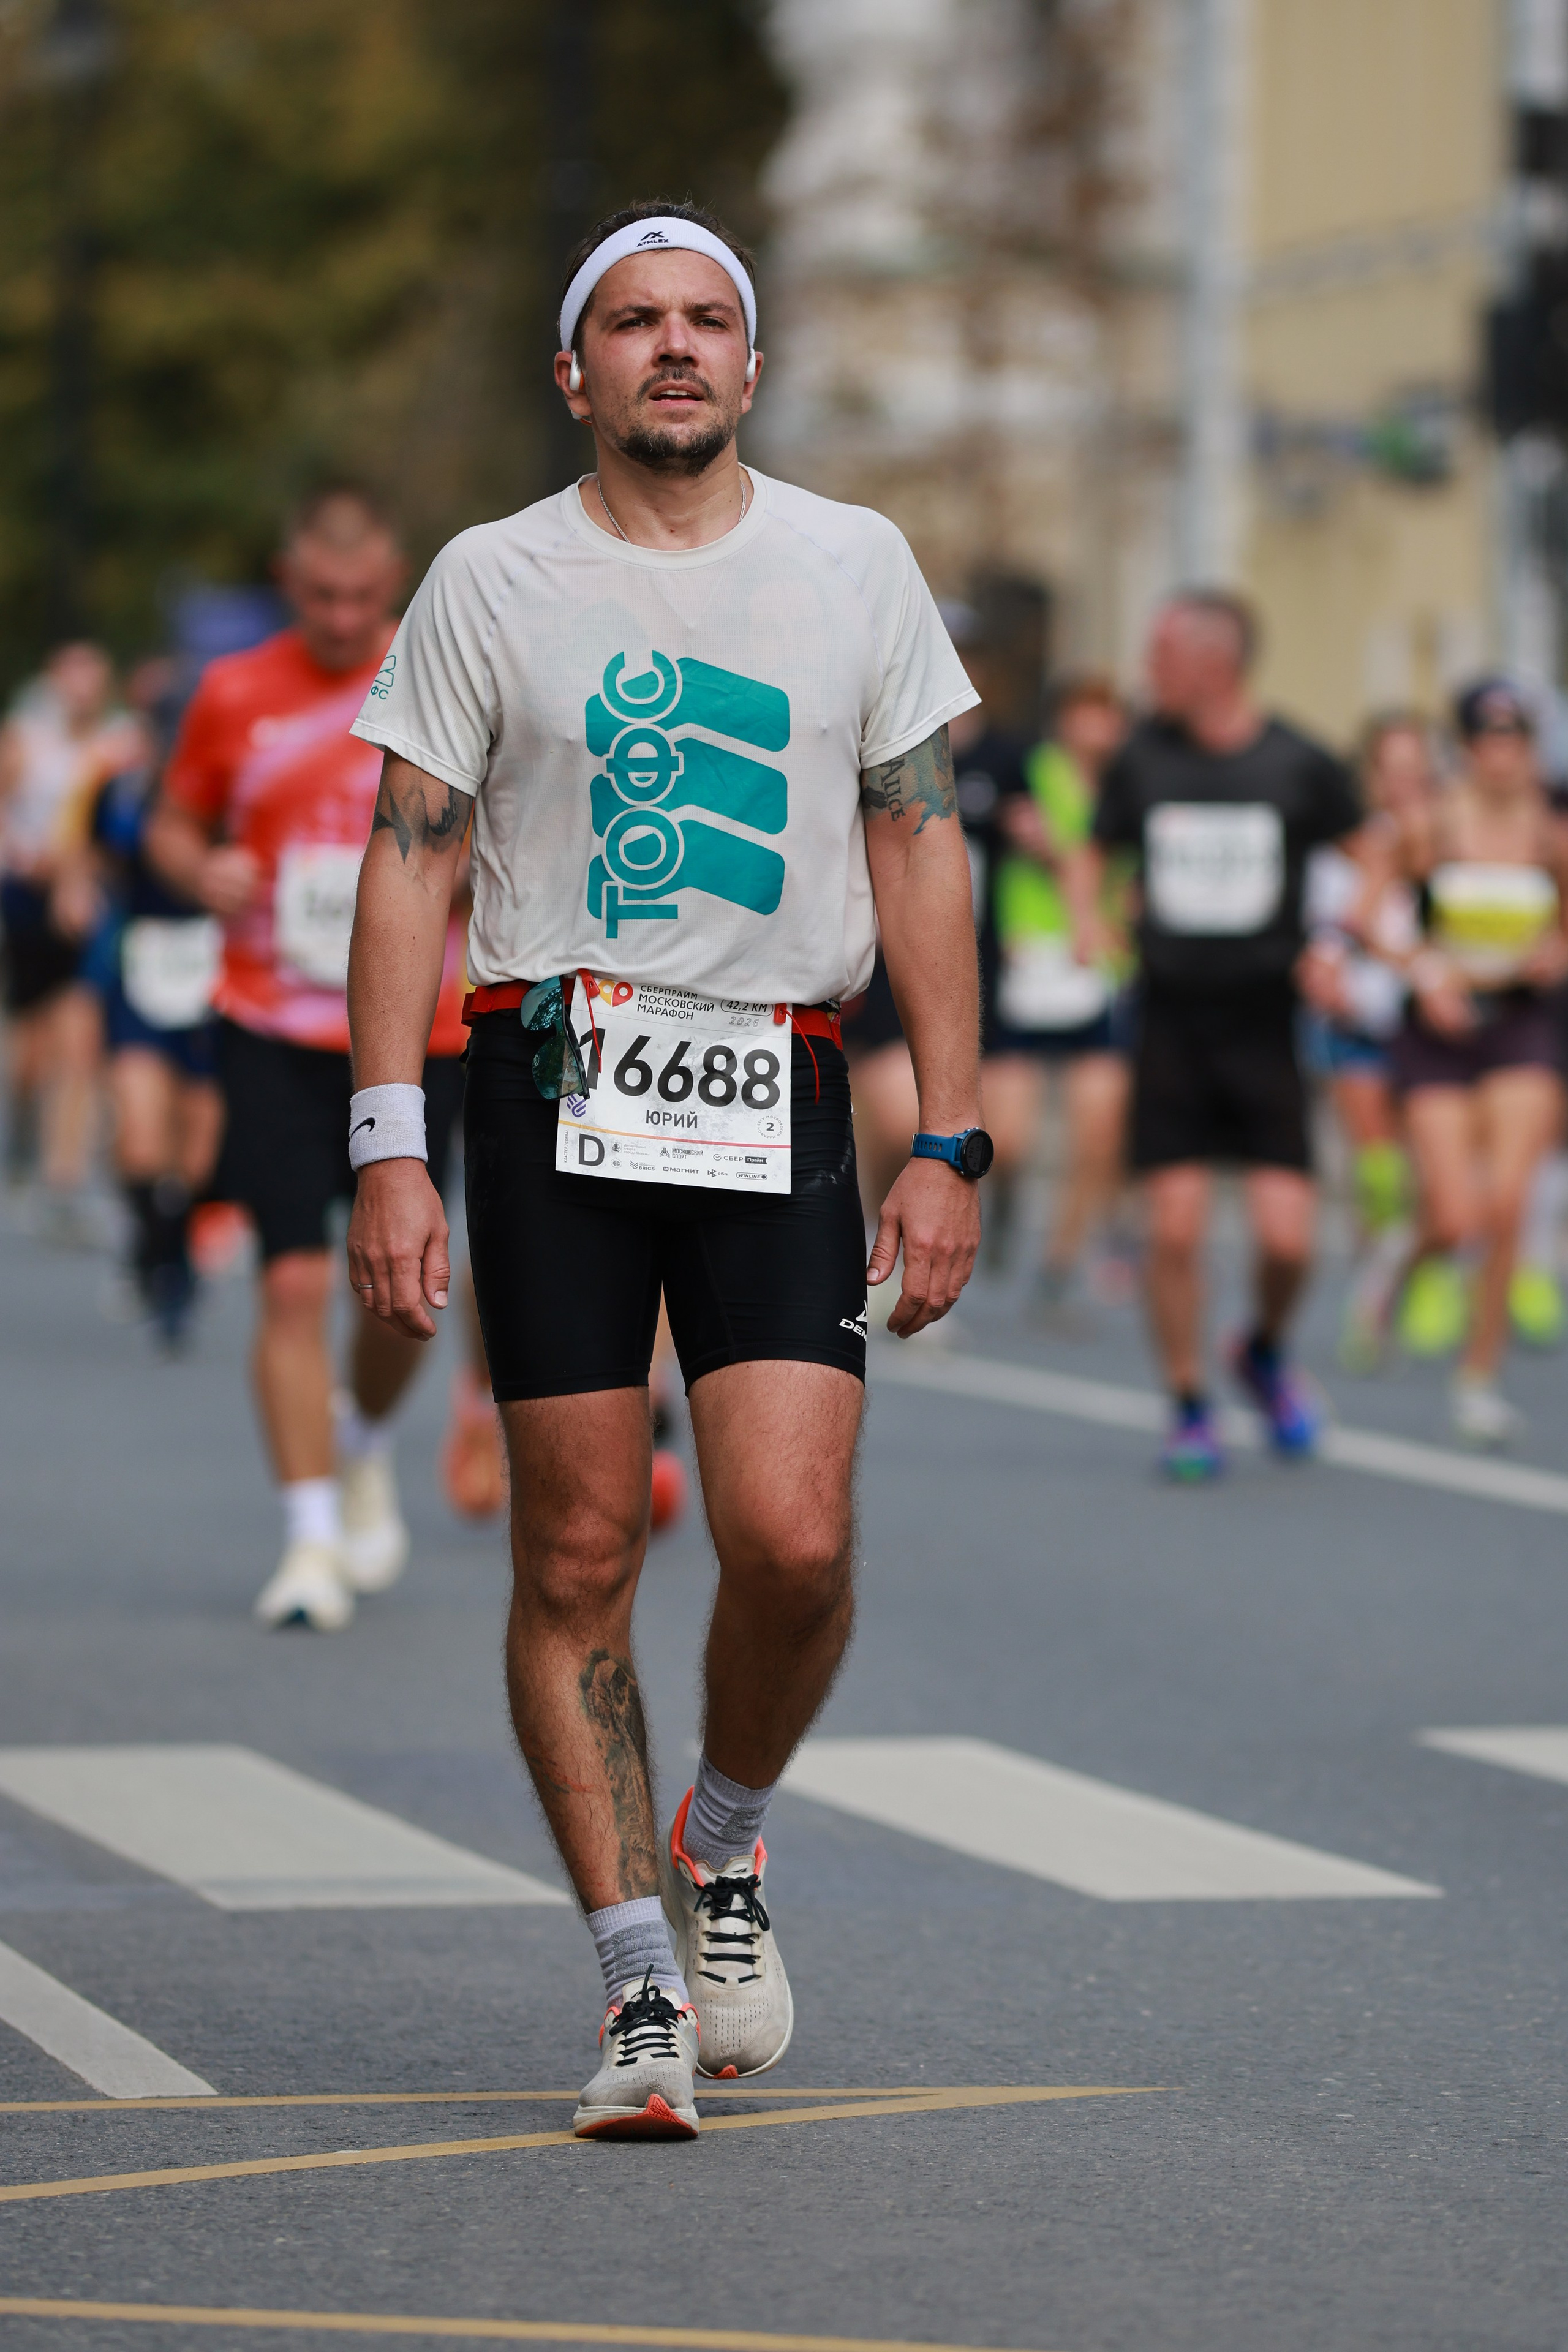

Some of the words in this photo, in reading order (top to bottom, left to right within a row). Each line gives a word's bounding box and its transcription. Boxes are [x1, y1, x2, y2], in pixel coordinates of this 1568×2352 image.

[636, 239, 669, 247] ATHLEX
[603, 650, 679, 939] ТОФС
[640, 985, 698, 1000] СБЕРПРАЙМ
[638, 993, 714, 1012] МОСКОВСКИЙ
[726, 1001, 749, 1011] 42,2
[637, 1004, 694, 1020] МАРАФОН
[728, 1016, 760, 1028] 2026
[579, 1028, 780, 1110] 16688
[646, 1109, 698, 1129] ЮРИЙ
[766, 1122, 774, 1131] 2
[578, 1133, 605, 1166] D
